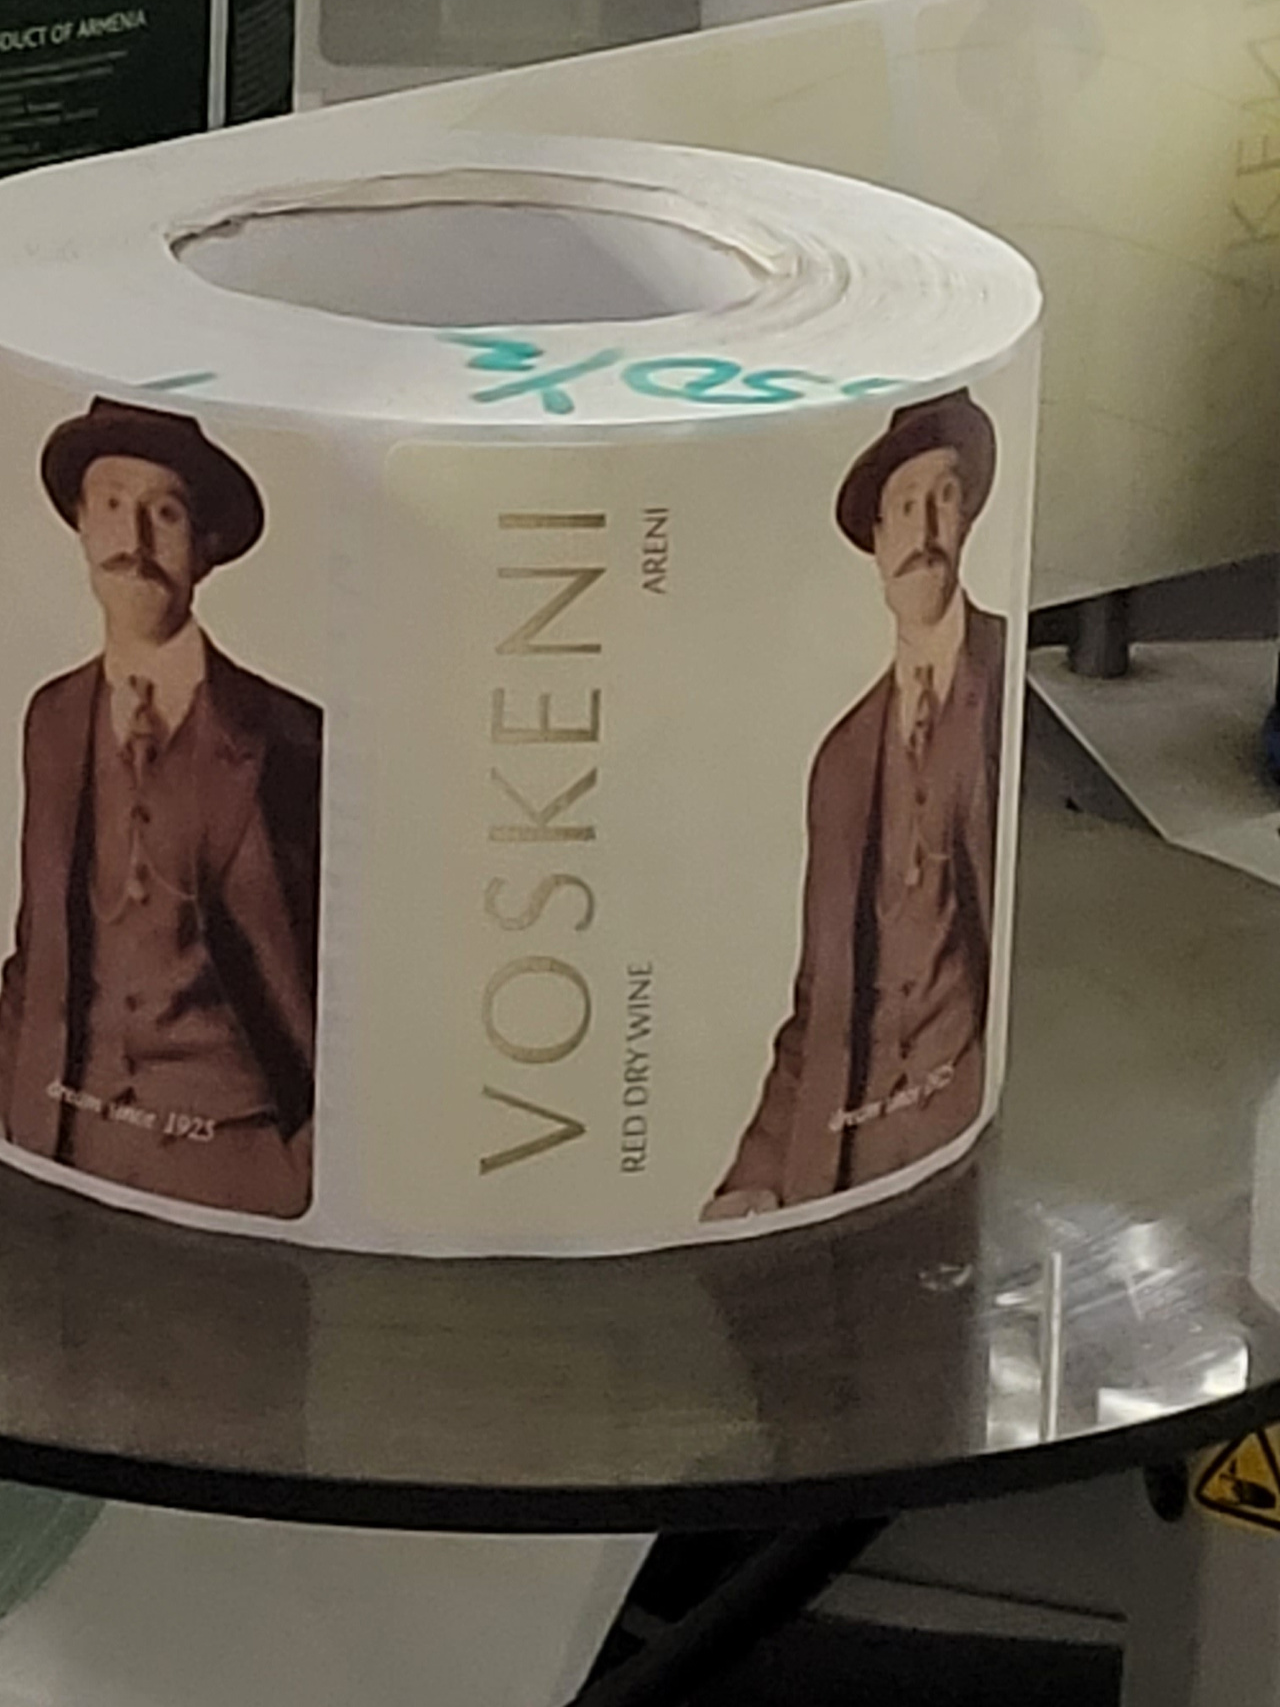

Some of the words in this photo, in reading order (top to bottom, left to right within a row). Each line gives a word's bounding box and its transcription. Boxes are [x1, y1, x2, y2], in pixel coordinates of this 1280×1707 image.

[50, 22, 74, 45] OF
[76, 8, 148, 40] ARMENIA
[641, 507, 670, 595] ARENI
[478, 512, 608, 1177] VOSKENI
[626, 962, 654, 1042] WINE
[623, 1048, 650, 1107] DRY
[620, 1115, 648, 1174] RED
